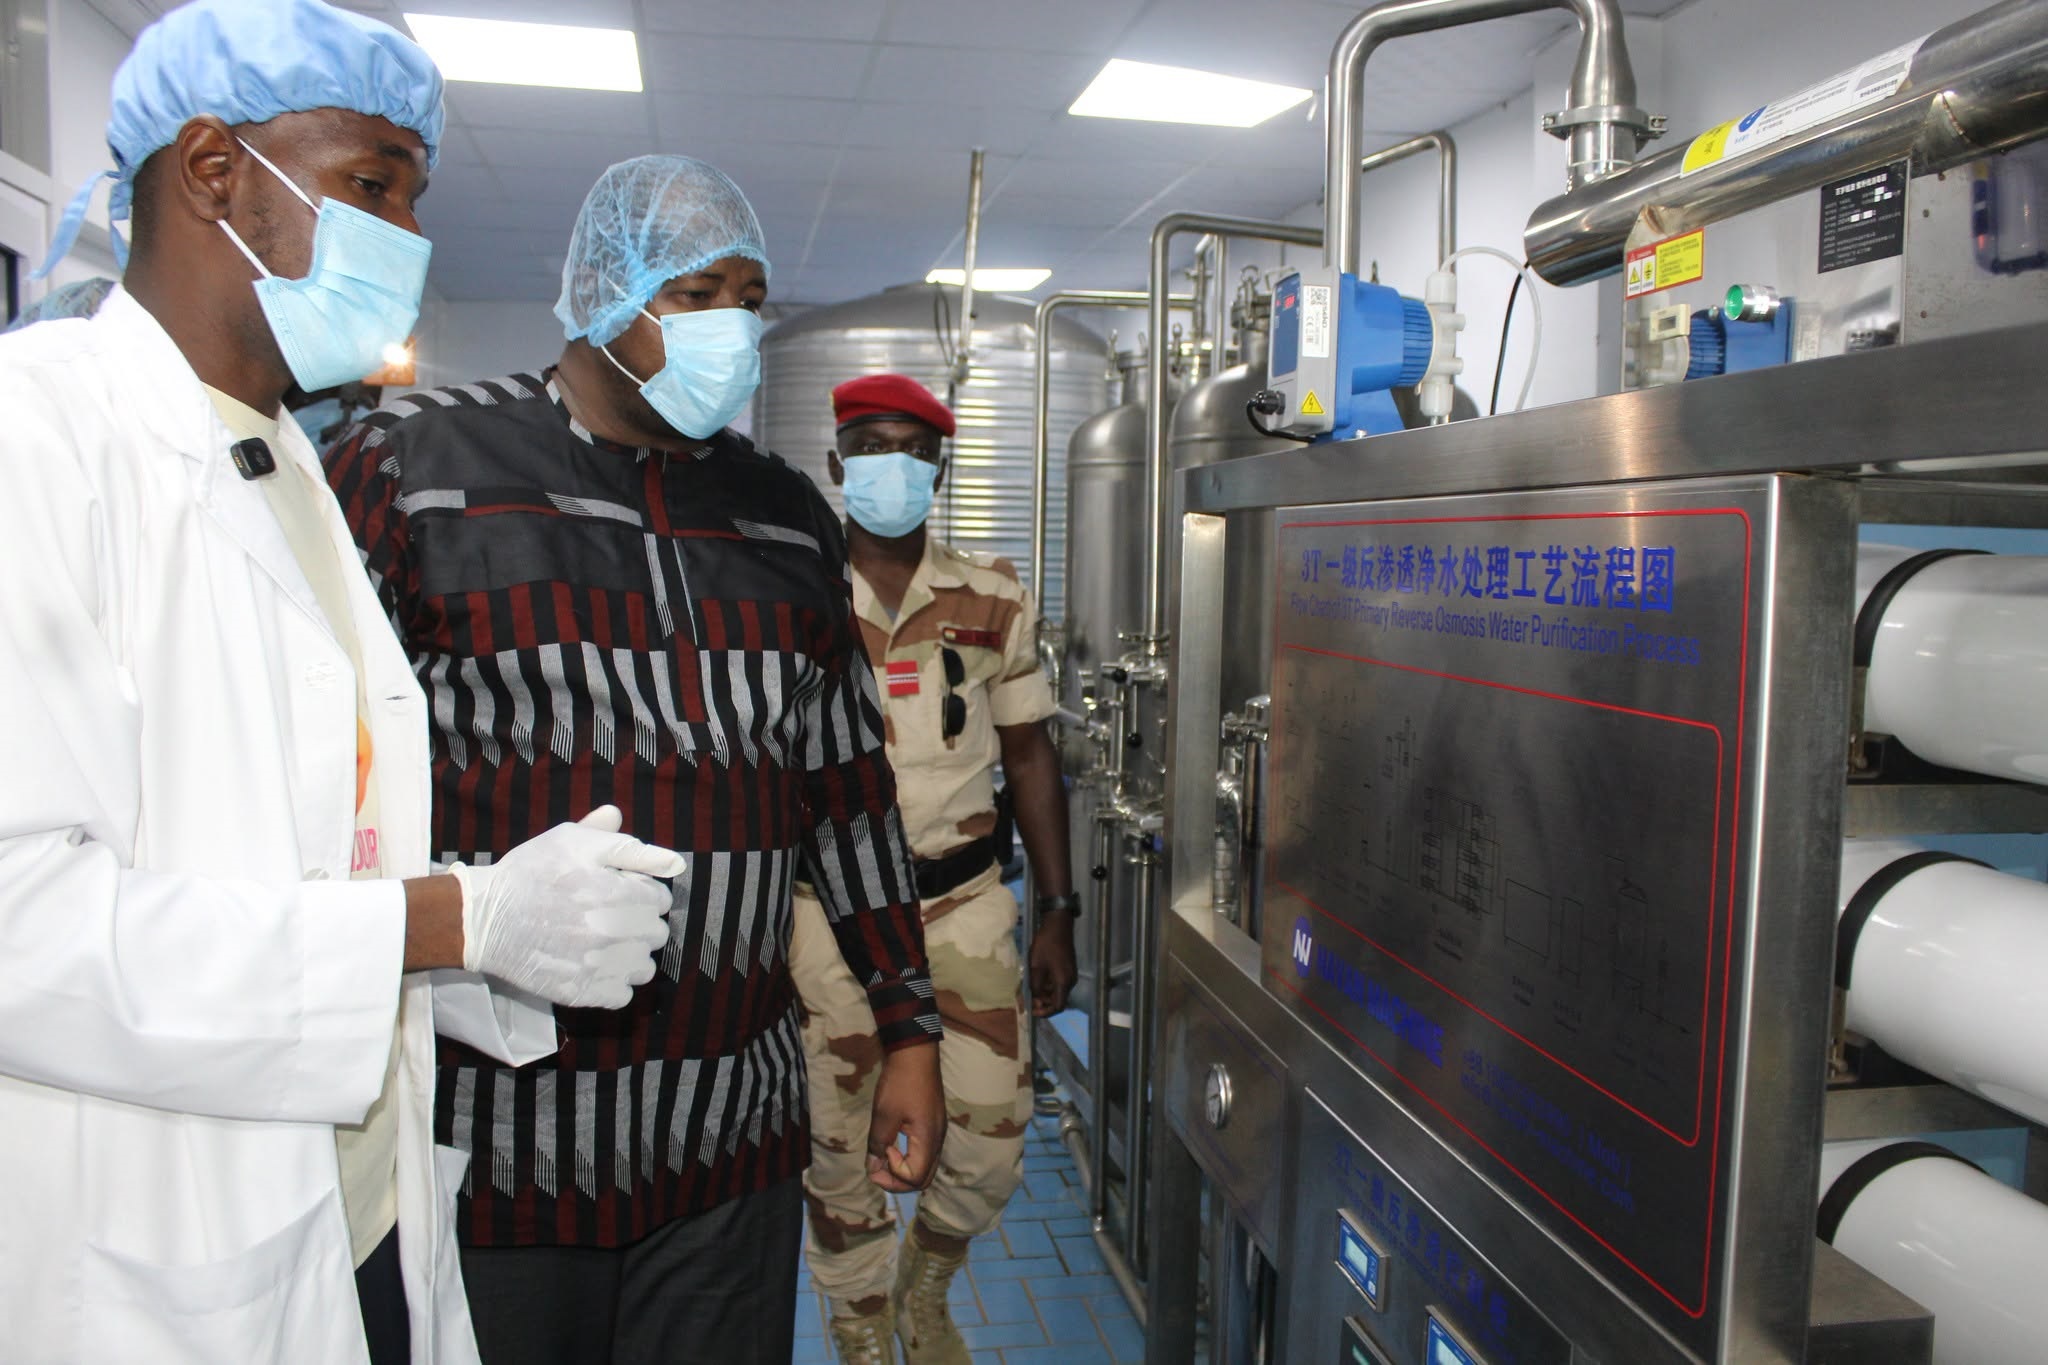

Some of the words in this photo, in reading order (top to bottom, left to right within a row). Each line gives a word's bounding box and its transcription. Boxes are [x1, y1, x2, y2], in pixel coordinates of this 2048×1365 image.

[1354, 598, 1390, 633] Primary
[1391, 601, 1433, 632] Reverse
[1435, 605, 1486, 638] Osmosis
[1488, 611, 1529, 643] Water
[1531, 614, 1619, 655] Purification
[1623, 622, 1700, 666] Process
